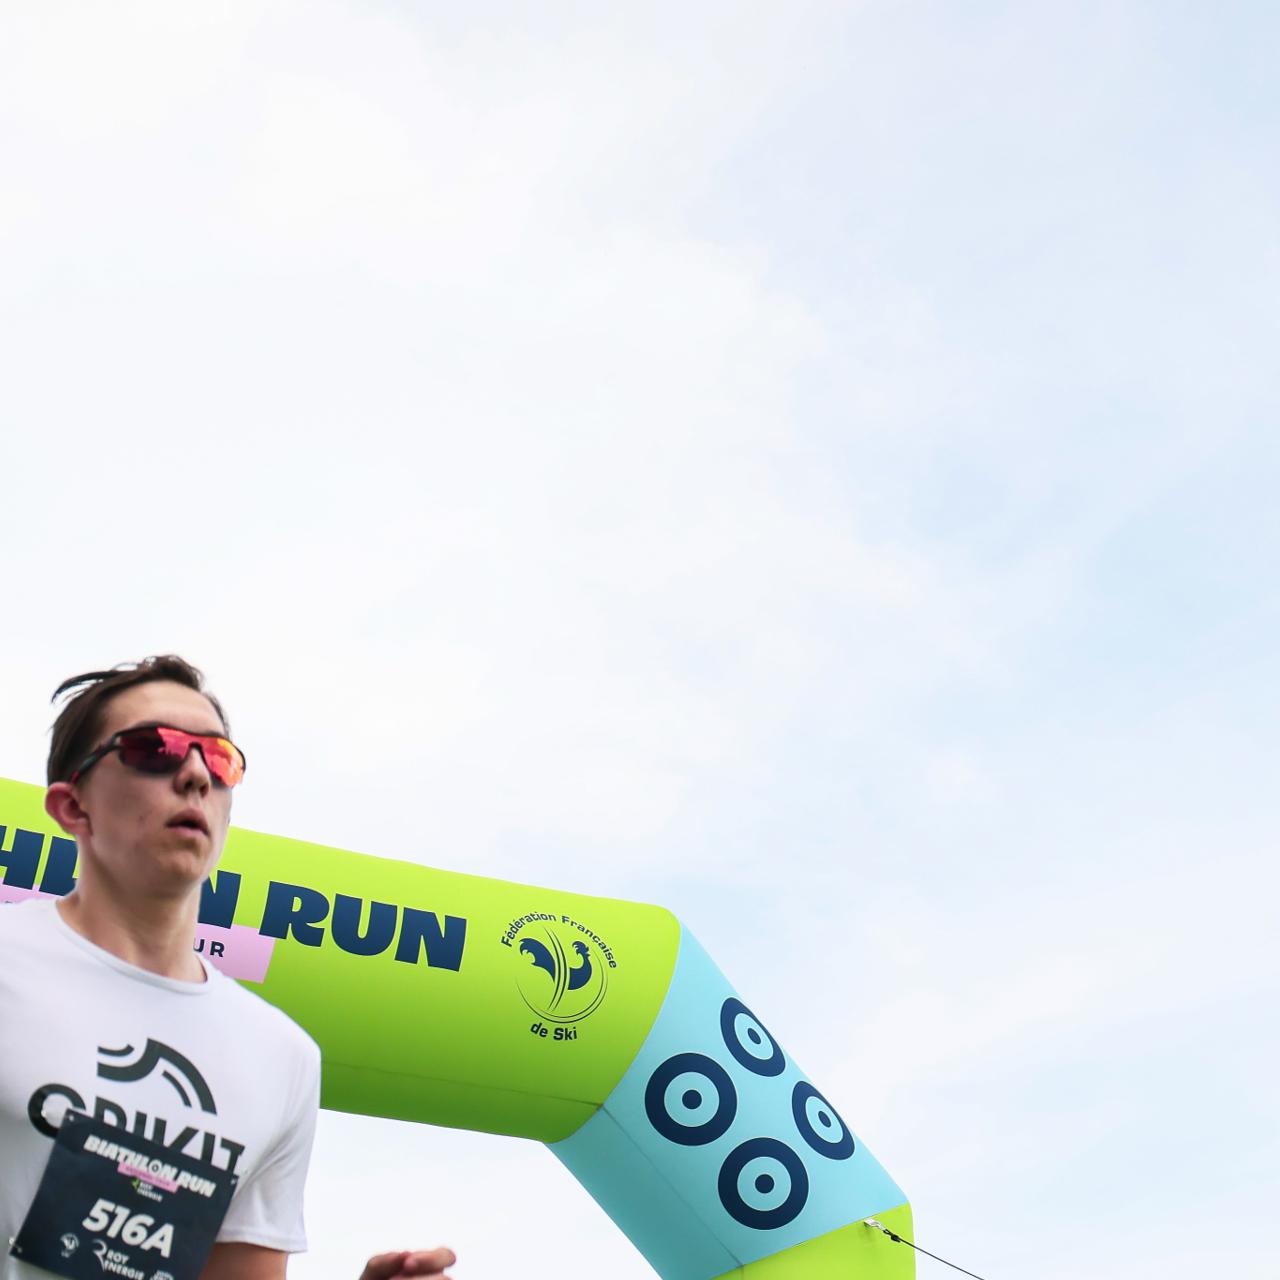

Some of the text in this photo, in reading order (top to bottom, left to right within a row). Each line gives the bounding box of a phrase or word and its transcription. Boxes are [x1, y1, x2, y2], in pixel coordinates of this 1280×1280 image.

[259, 880, 467, 972] RUN
[500, 911, 617, 969] Fédération Française
[530, 1022, 578, 1041] de Ski
[83, 1133, 179, 1182] BIATHLON
[176, 1169, 217, 1198] RUN
[82, 1198, 174, 1258] 516A
[106, 1249, 130, 1265] ROY
